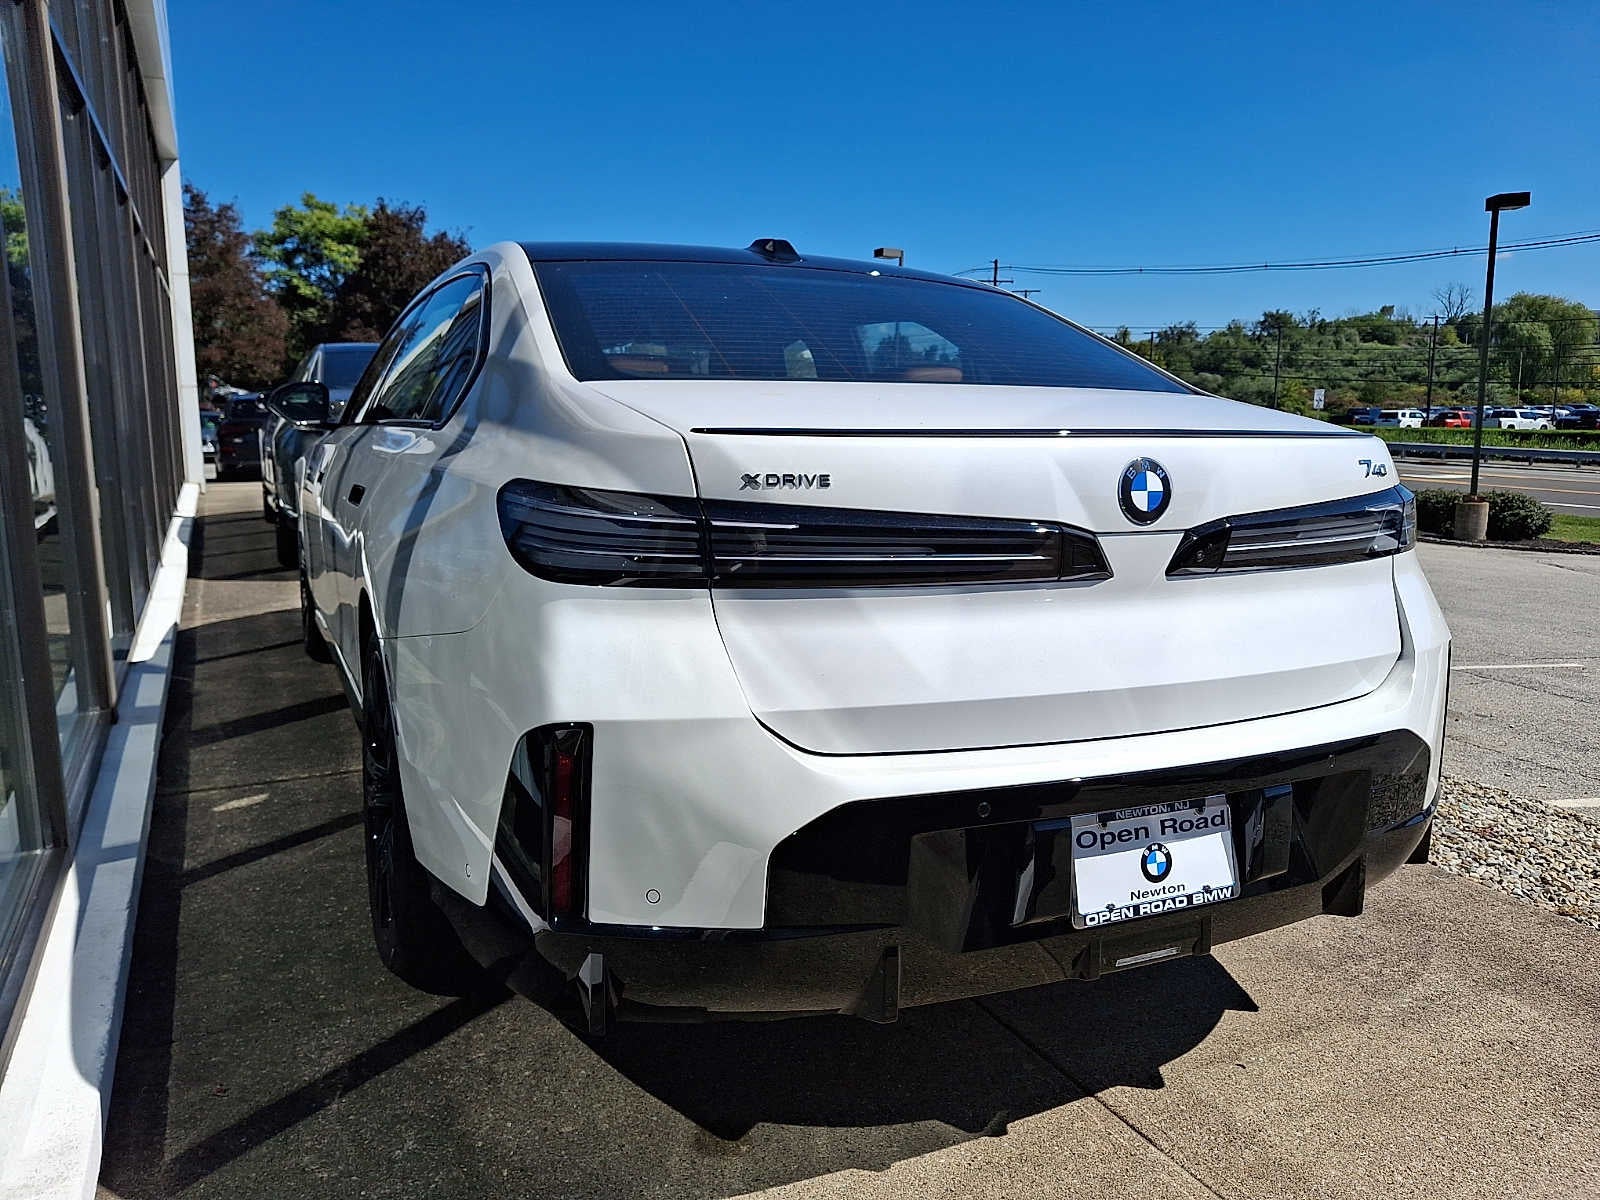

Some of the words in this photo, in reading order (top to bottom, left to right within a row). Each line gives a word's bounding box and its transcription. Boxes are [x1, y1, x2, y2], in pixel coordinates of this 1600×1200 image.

[1126, 460, 1166, 480] BMW
[1359, 459, 1387, 478] 740
[1174, 800, 1190, 811] NJ
[1076, 825, 1150, 850] Open
[1159, 809, 1226, 836] Road
[1143, 844, 1168, 857] BMW
[1130, 884, 1186, 902] Newton
[1085, 906, 1134, 926] OPEN
[1140, 896, 1188, 916] ROAD
[1192, 886, 1233, 904] BMW
